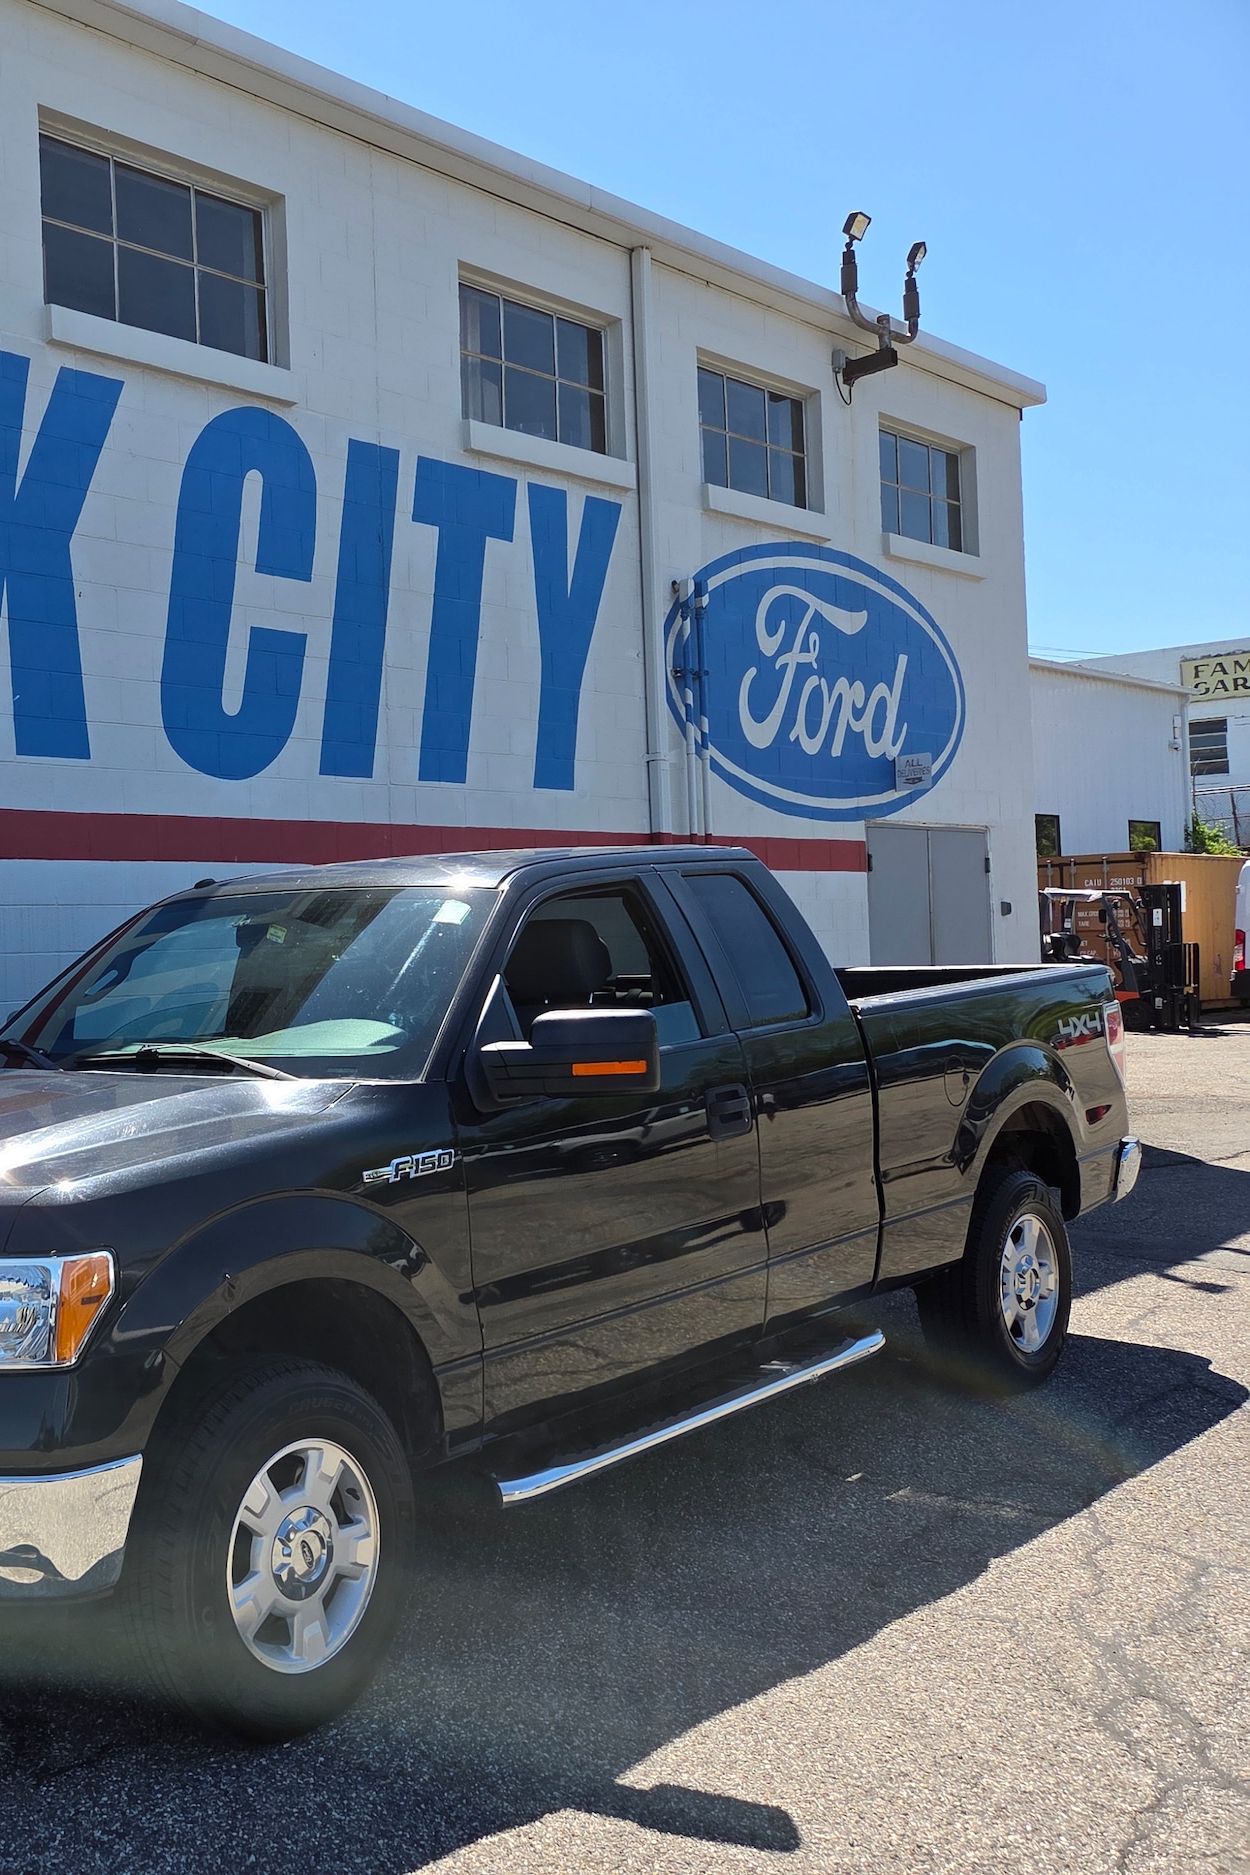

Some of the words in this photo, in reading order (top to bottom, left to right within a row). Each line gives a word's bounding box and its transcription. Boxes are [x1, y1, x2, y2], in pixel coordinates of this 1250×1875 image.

[160, 405, 623, 791] CITY
[738, 584, 909, 761] Ford
[904, 759, 924, 768] ALL
[897, 766, 931, 778] DELIVERIES
[1084, 878, 1102, 887] CAIU
[1110, 877, 1134, 886] 250103
